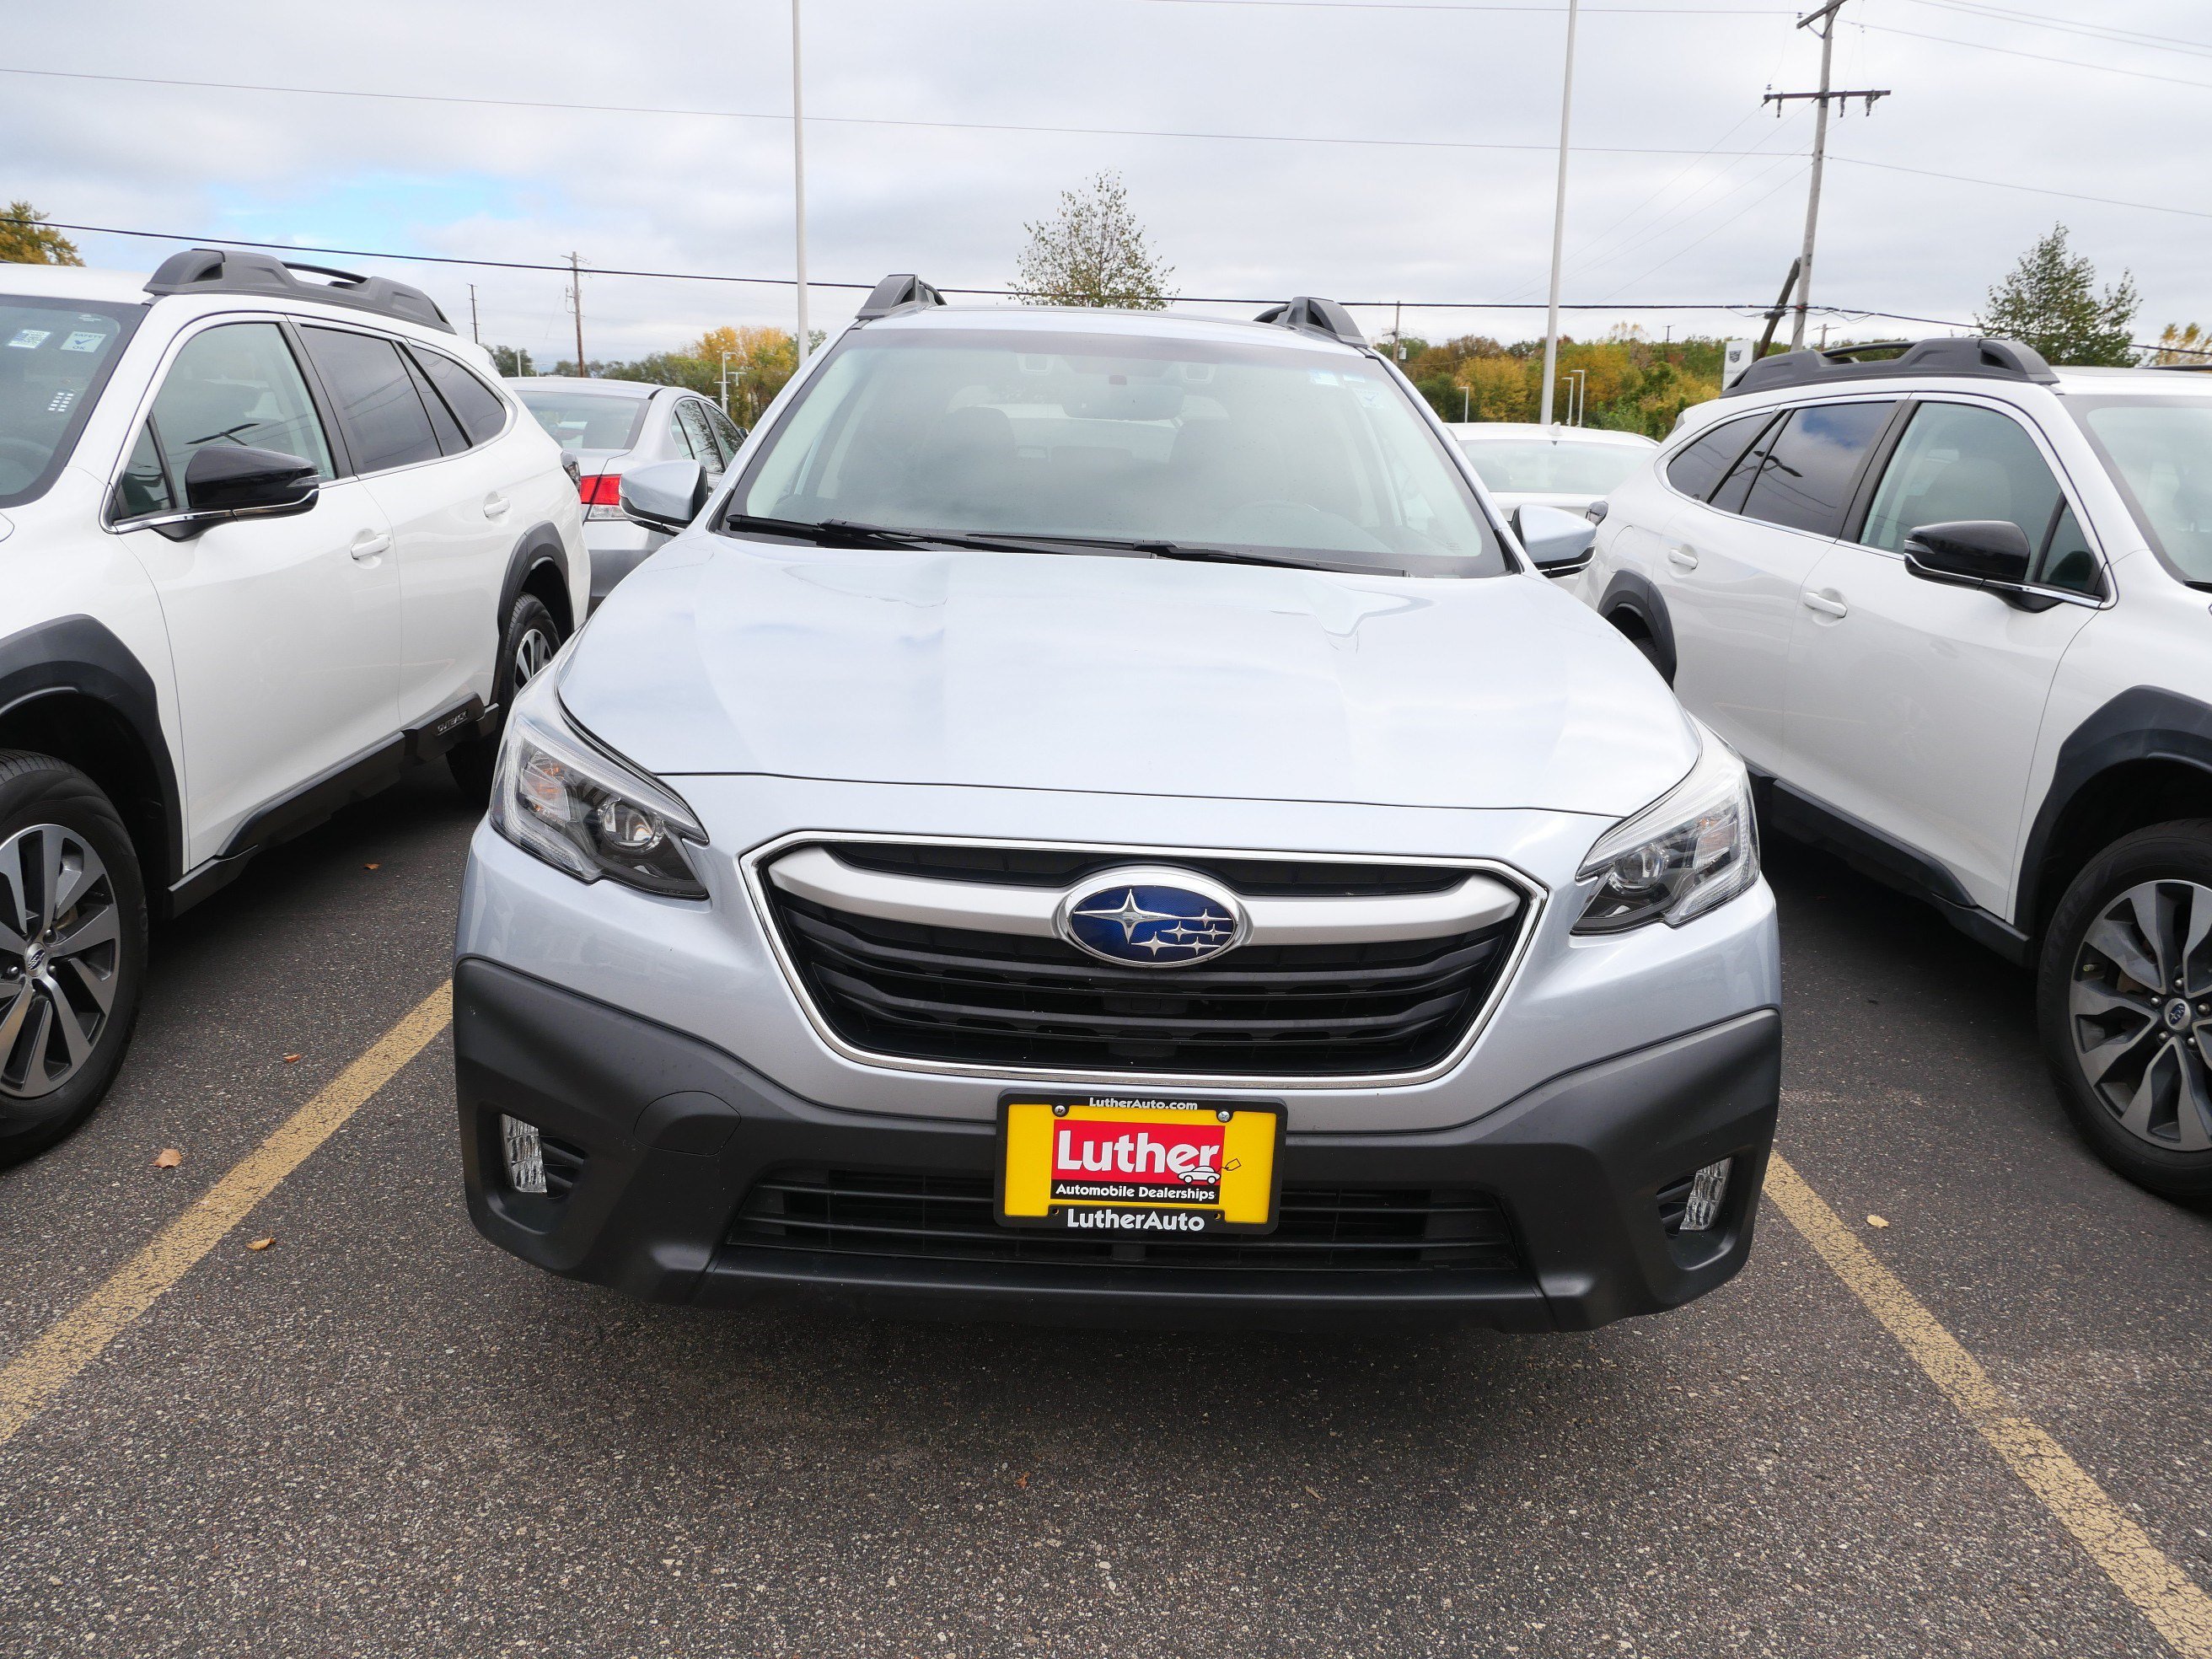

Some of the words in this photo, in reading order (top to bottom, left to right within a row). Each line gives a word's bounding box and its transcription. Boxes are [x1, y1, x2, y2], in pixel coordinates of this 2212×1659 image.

[438, 711, 467, 732] OUTBACK
[1088, 1097, 1198, 1110] LutherAuto.com
[1056, 1130, 1221, 1173] Luther
[1055, 1184, 1135, 1198] Automobile
[1138, 1186, 1216, 1201] Dealerships
[1066, 1208, 1205, 1231] LutherAuto
